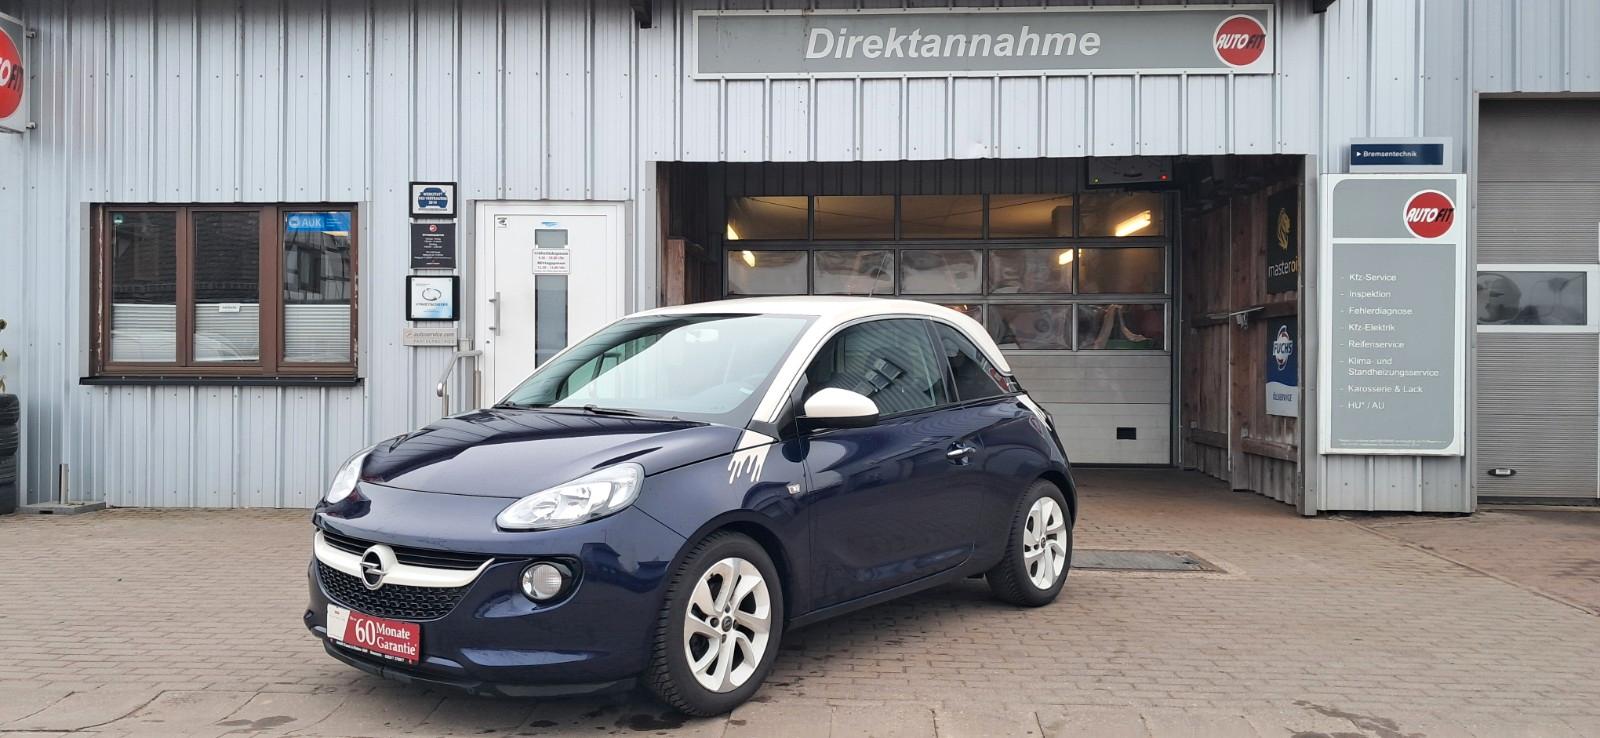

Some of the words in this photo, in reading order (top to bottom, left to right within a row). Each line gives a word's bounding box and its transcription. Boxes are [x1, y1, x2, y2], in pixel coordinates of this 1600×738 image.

[805, 26, 1101, 59] Direktannahme
[1215, 33, 1266, 49] AUTOFIT
[1363, 150, 1418, 158] Bremsentechnik
[1406, 207, 1455, 223] AUTOFIT
[302, 217, 321, 227] AUK
[1349, 273, 1397, 281] Kfz-Service
[1349, 289, 1392, 299] Inspektion
[1348, 306, 1414, 316] Fehlerdiagnose
[1348, 323, 1395, 332] Kfz-Elektrik
[1273, 342, 1292, 354] FUCHS
[1348, 340, 1405, 348] Reifenservice
[1348, 357, 1375, 365] Klima-
[1376, 357, 1393, 365] und
[1348, 367, 1440, 377] Standheizungsservice
[1348, 384, 1393, 393] Karosserie
[1394, 384, 1401, 393] &
[1403, 384, 1424, 393] Lack
[1371, 401, 1385, 409] AU
[355, 618, 376, 646] 60
[376, 622, 411, 640] Monate
